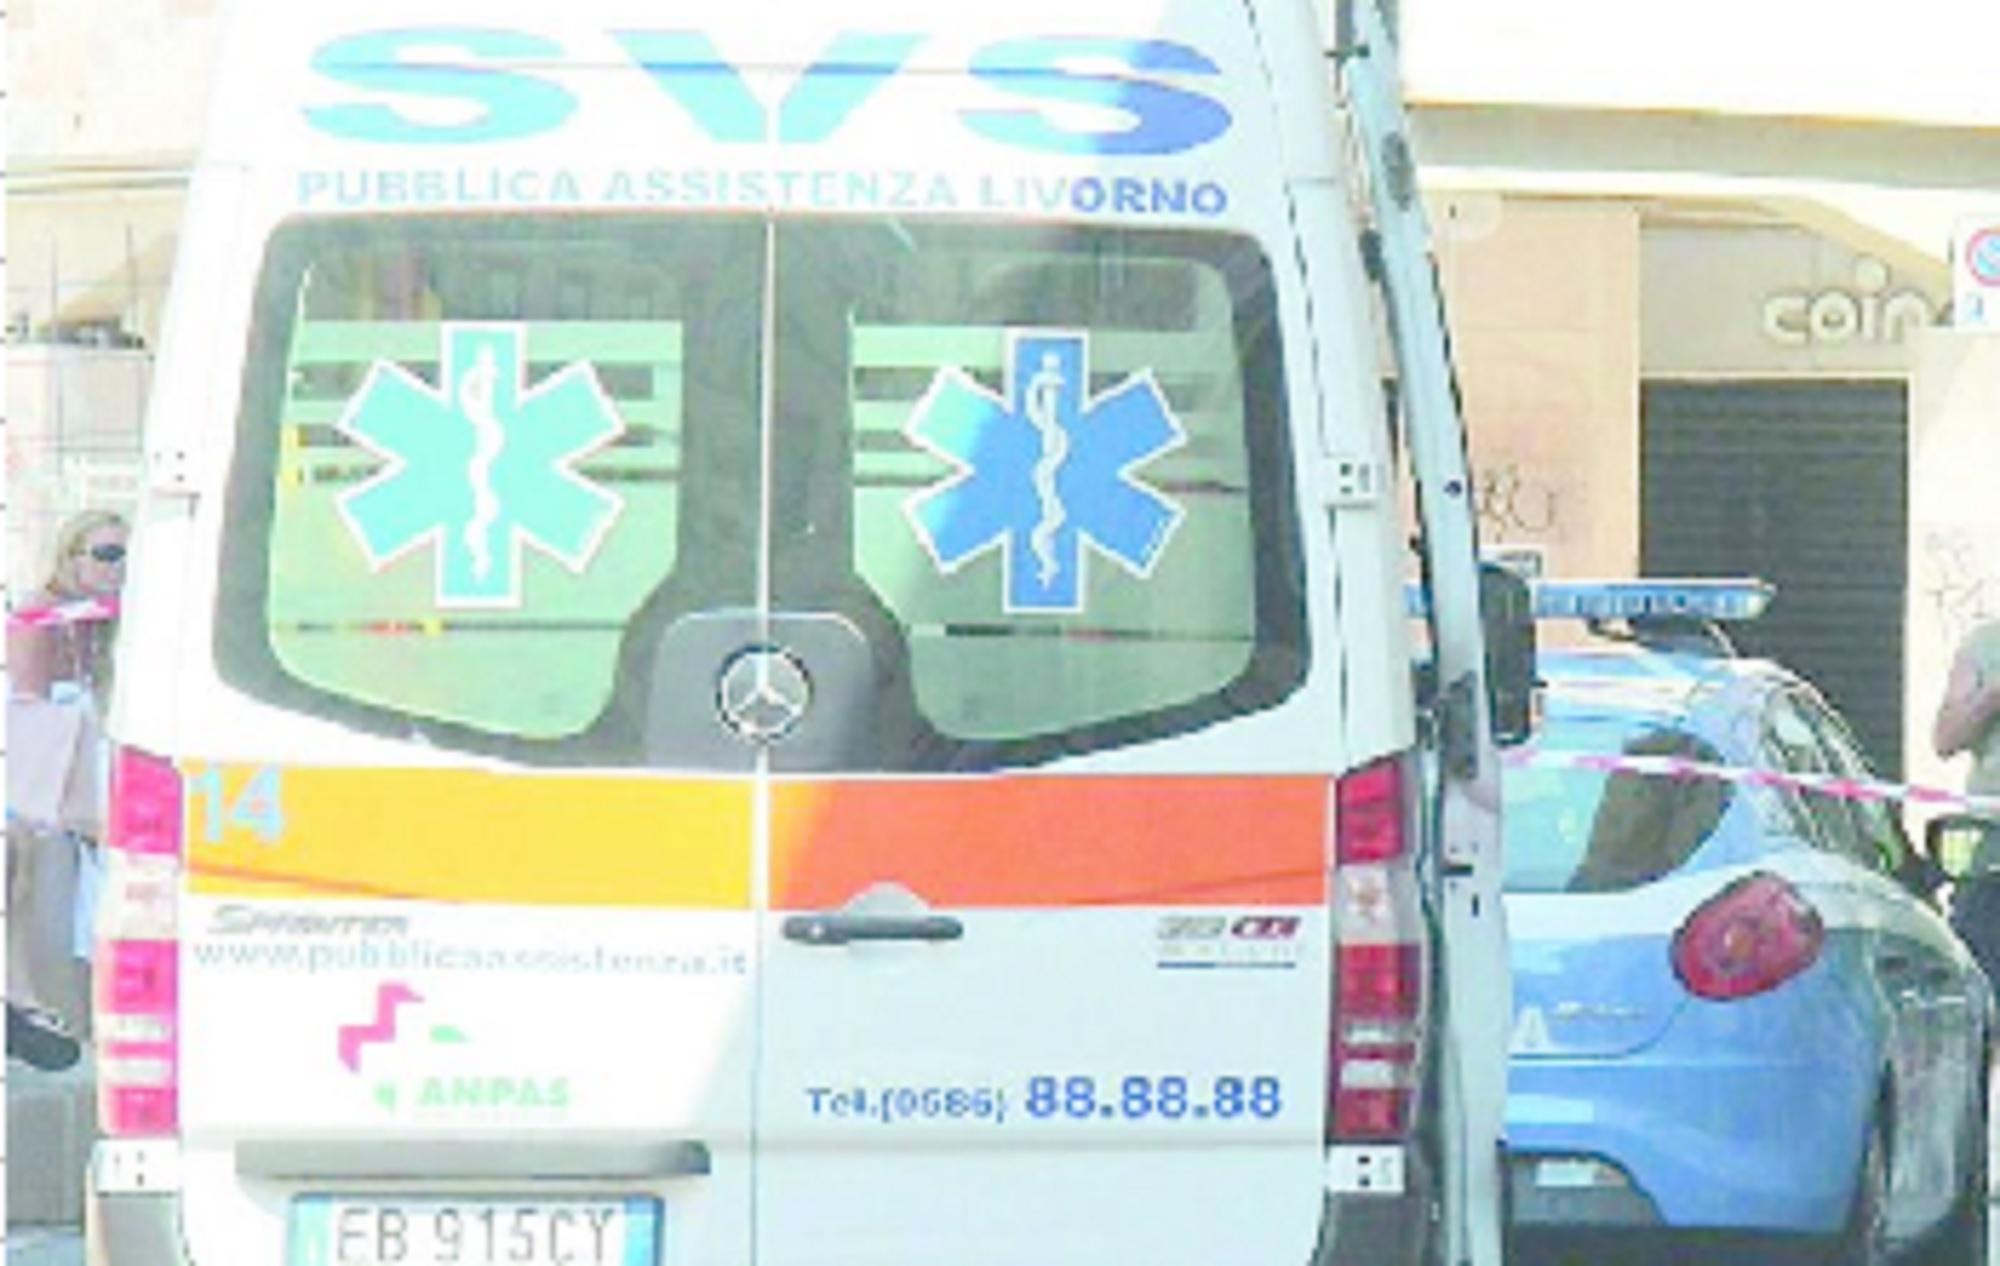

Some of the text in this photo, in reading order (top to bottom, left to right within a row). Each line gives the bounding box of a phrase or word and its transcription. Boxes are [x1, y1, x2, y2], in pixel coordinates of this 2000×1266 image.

[302, 26, 1233, 156] SVS
[297, 169, 1228, 215] PUBBLICA ASSISTENZA LIVORNO
[188, 763, 285, 843] 14
[418, 1075, 570, 1107] ANPAS
[1025, 1075, 1281, 1119] 88.88.88
[337, 1207, 408, 1262] EB
